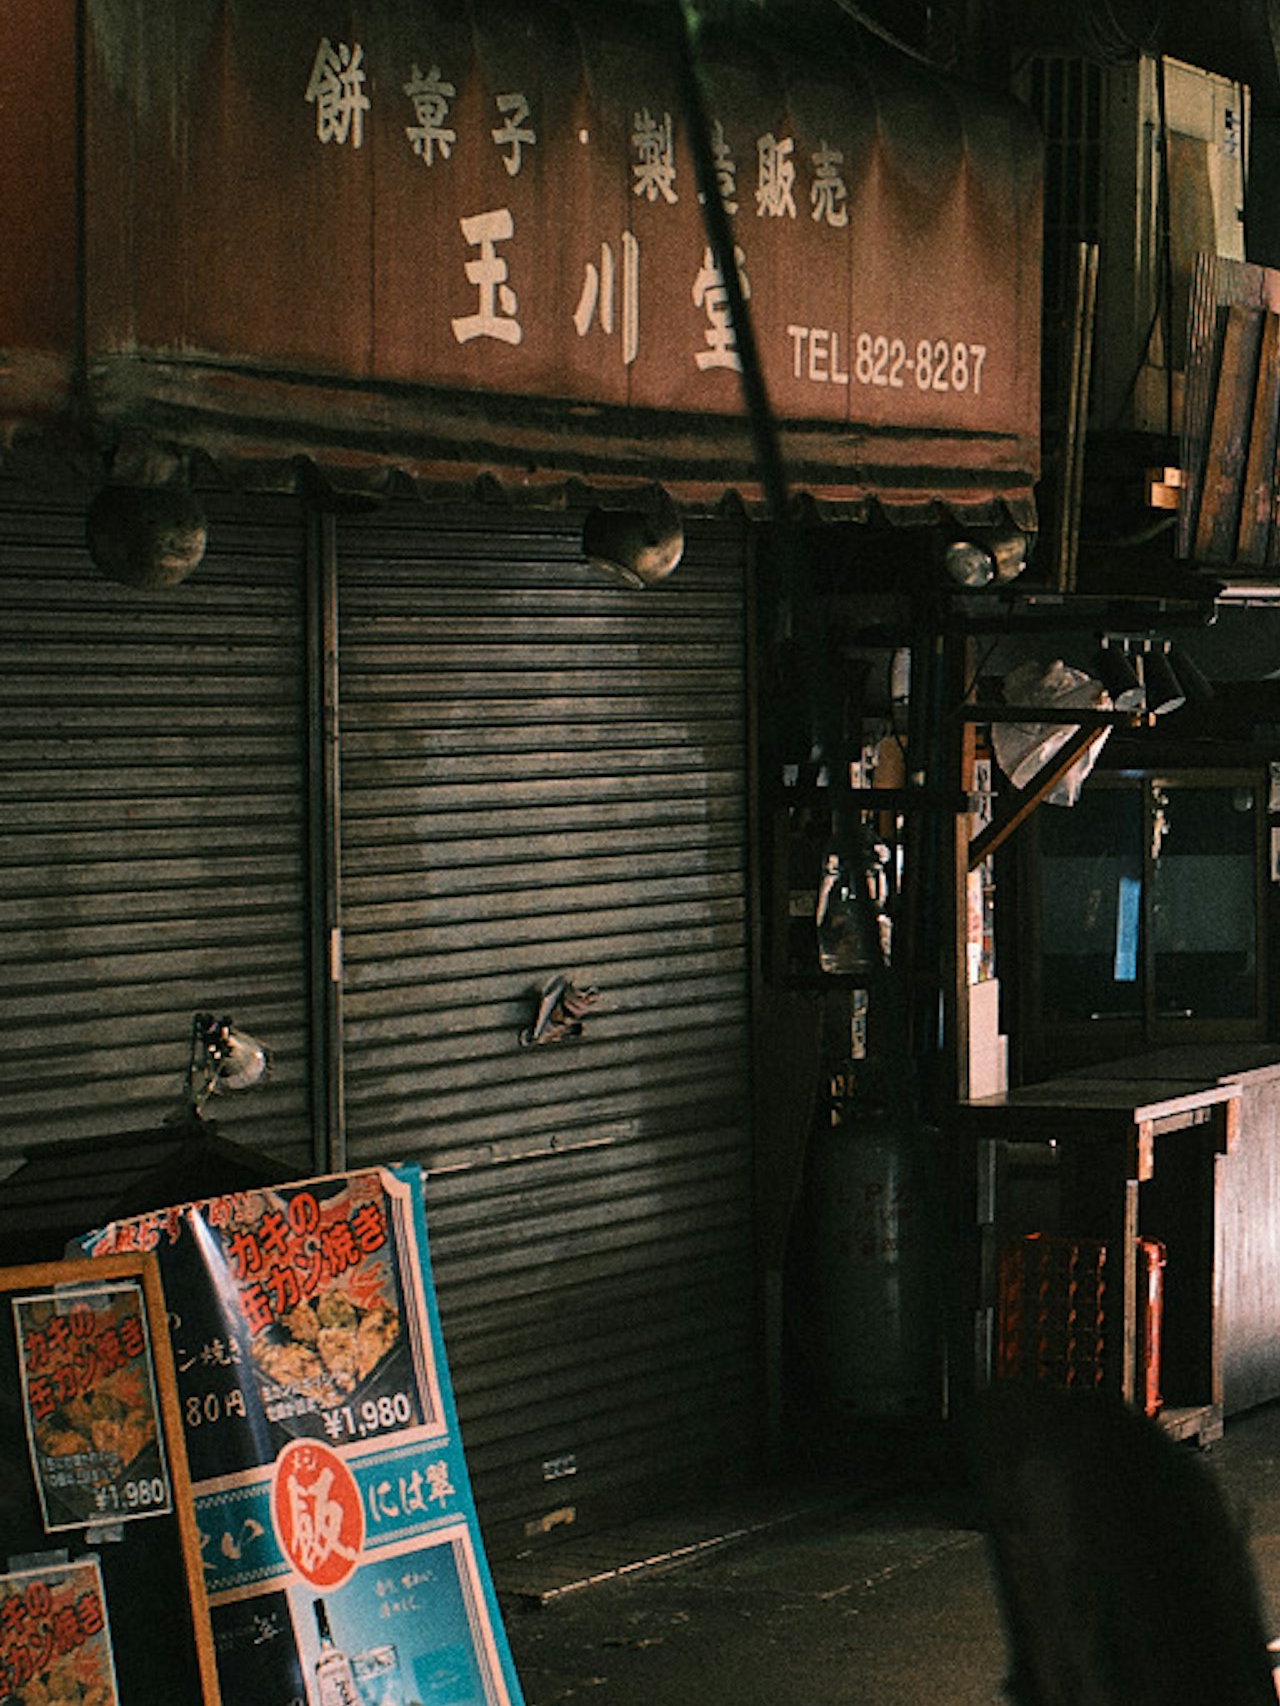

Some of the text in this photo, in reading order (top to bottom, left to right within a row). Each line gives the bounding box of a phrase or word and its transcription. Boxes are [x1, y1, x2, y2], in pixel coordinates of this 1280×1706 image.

[451, 207, 751, 374] 玉川堂
[787, 324, 987, 394] TEL 822-8287
[229, 1192, 320, 1280] カキの
[322, 1392, 411, 1440] ¥1,980
[95, 1477, 164, 1510] ¥1,980
